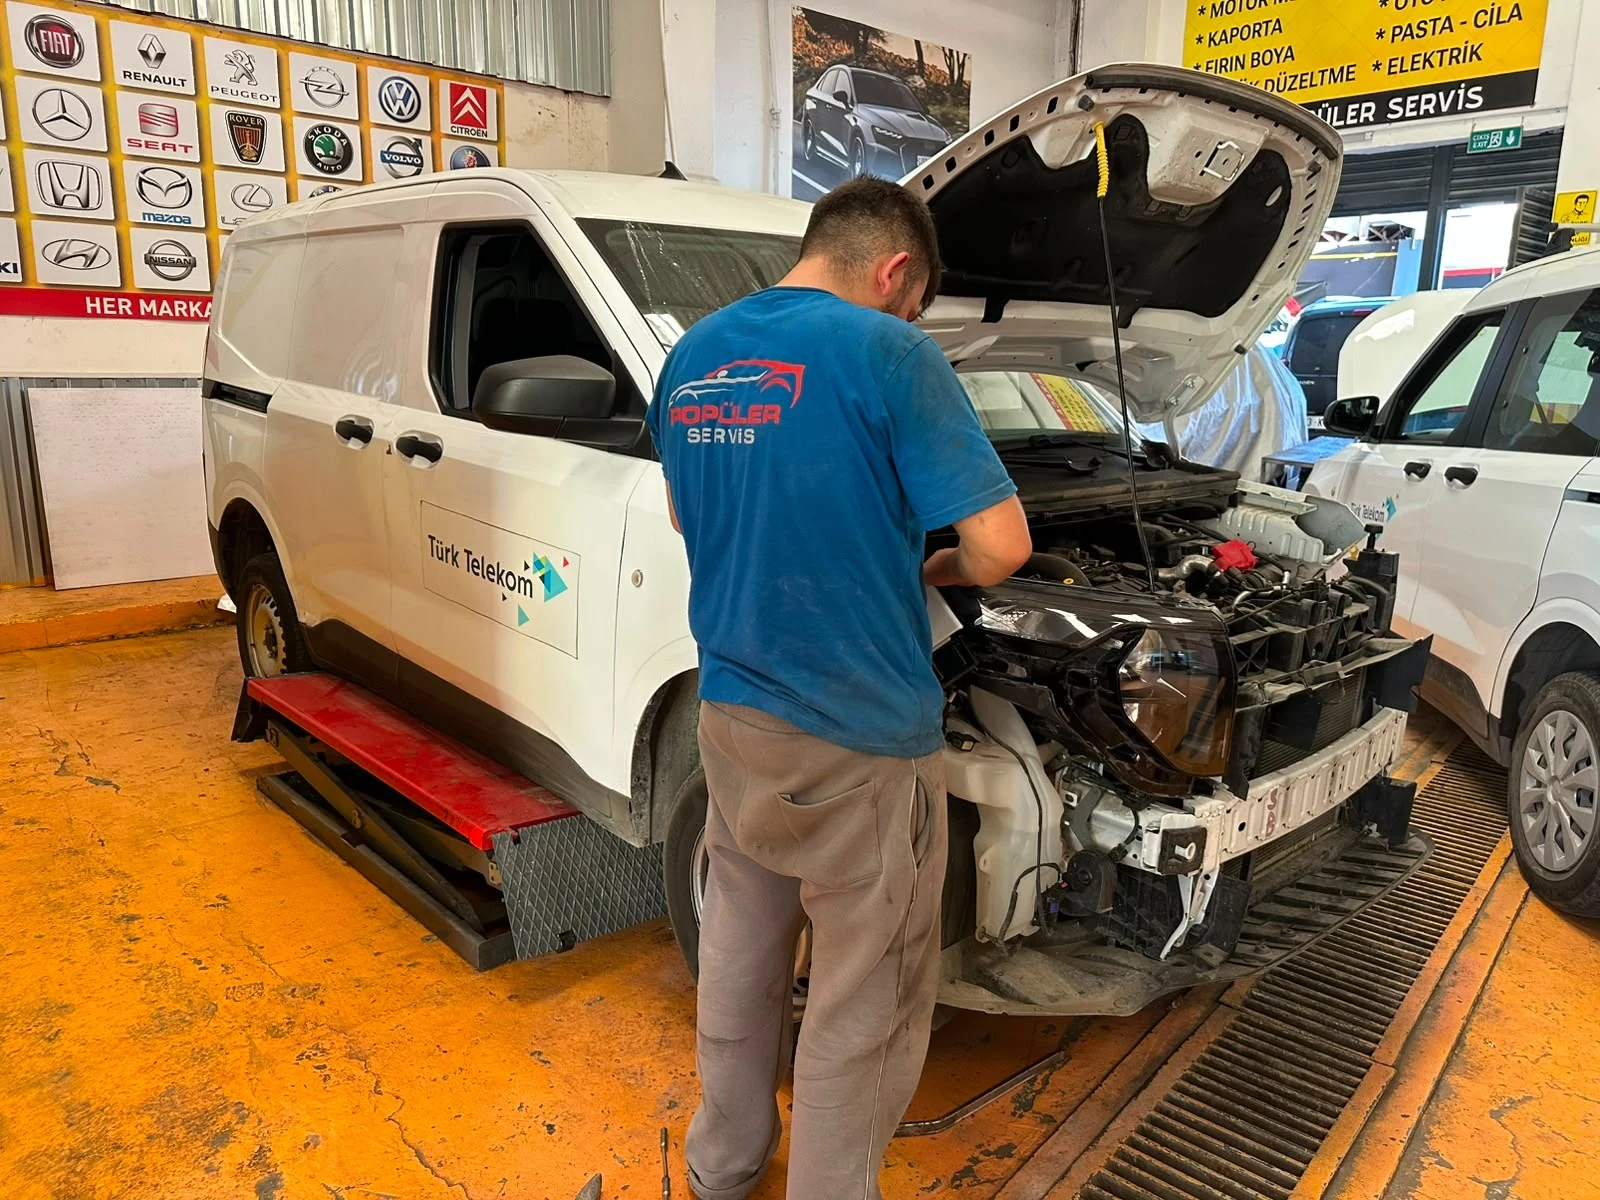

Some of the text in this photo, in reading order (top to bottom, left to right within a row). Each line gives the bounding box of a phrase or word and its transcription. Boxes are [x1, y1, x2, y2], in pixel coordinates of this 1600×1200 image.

[1391, 16, 1454, 43] PASTA
[1474, 2, 1523, 28] CİLA
[39, 29, 72, 56] FIAT
[1208, 18, 1283, 48] KAPORTA
[1205, 45, 1295, 74] FIRIN BOYA
[1387, 41, 1484, 75] ELEKTRİK
[123, 70, 187, 87] RENAULT
[1264, 64, 1357, 93] DÜZELTME
[211, 86, 278, 103] PEUGEOT
[229, 114, 263, 126] ROVER
[1310, 101, 1376, 127] ÜLER
[308, 126, 347, 146] SKODA
[450, 125, 488, 138] CITROËN
[127, 138, 193, 153] SEAT
[1472, 141, 1488, 149] EXIT
[316, 162, 342, 171] AUTO
[383, 153, 421, 164] VOLVO
[150, 256, 193, 266] NISSAN
[85, 297, 132, 315] HER
[670, 401, 782, 426] POPÜLER
[428, 534, 533, 599] Türk Telekom
